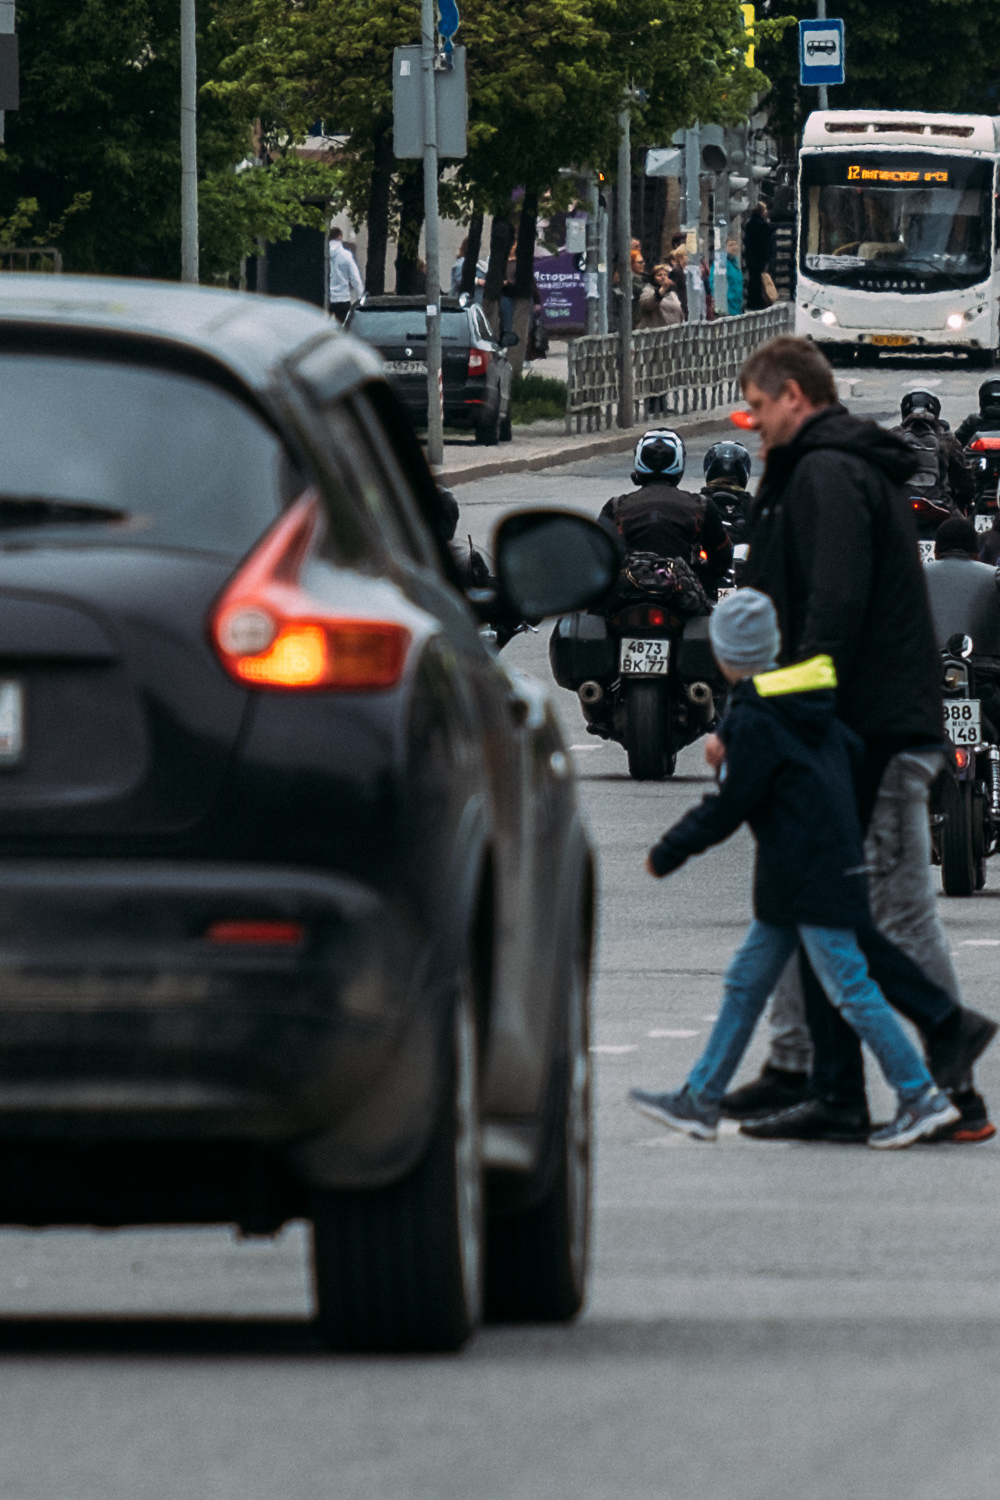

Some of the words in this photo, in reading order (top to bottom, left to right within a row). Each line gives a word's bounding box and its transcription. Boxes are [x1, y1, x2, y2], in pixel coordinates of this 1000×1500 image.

[628, 641, 662, 655] 4873
[648, 660, 664, 672] 77
[957, 727, 977, 742] 48
